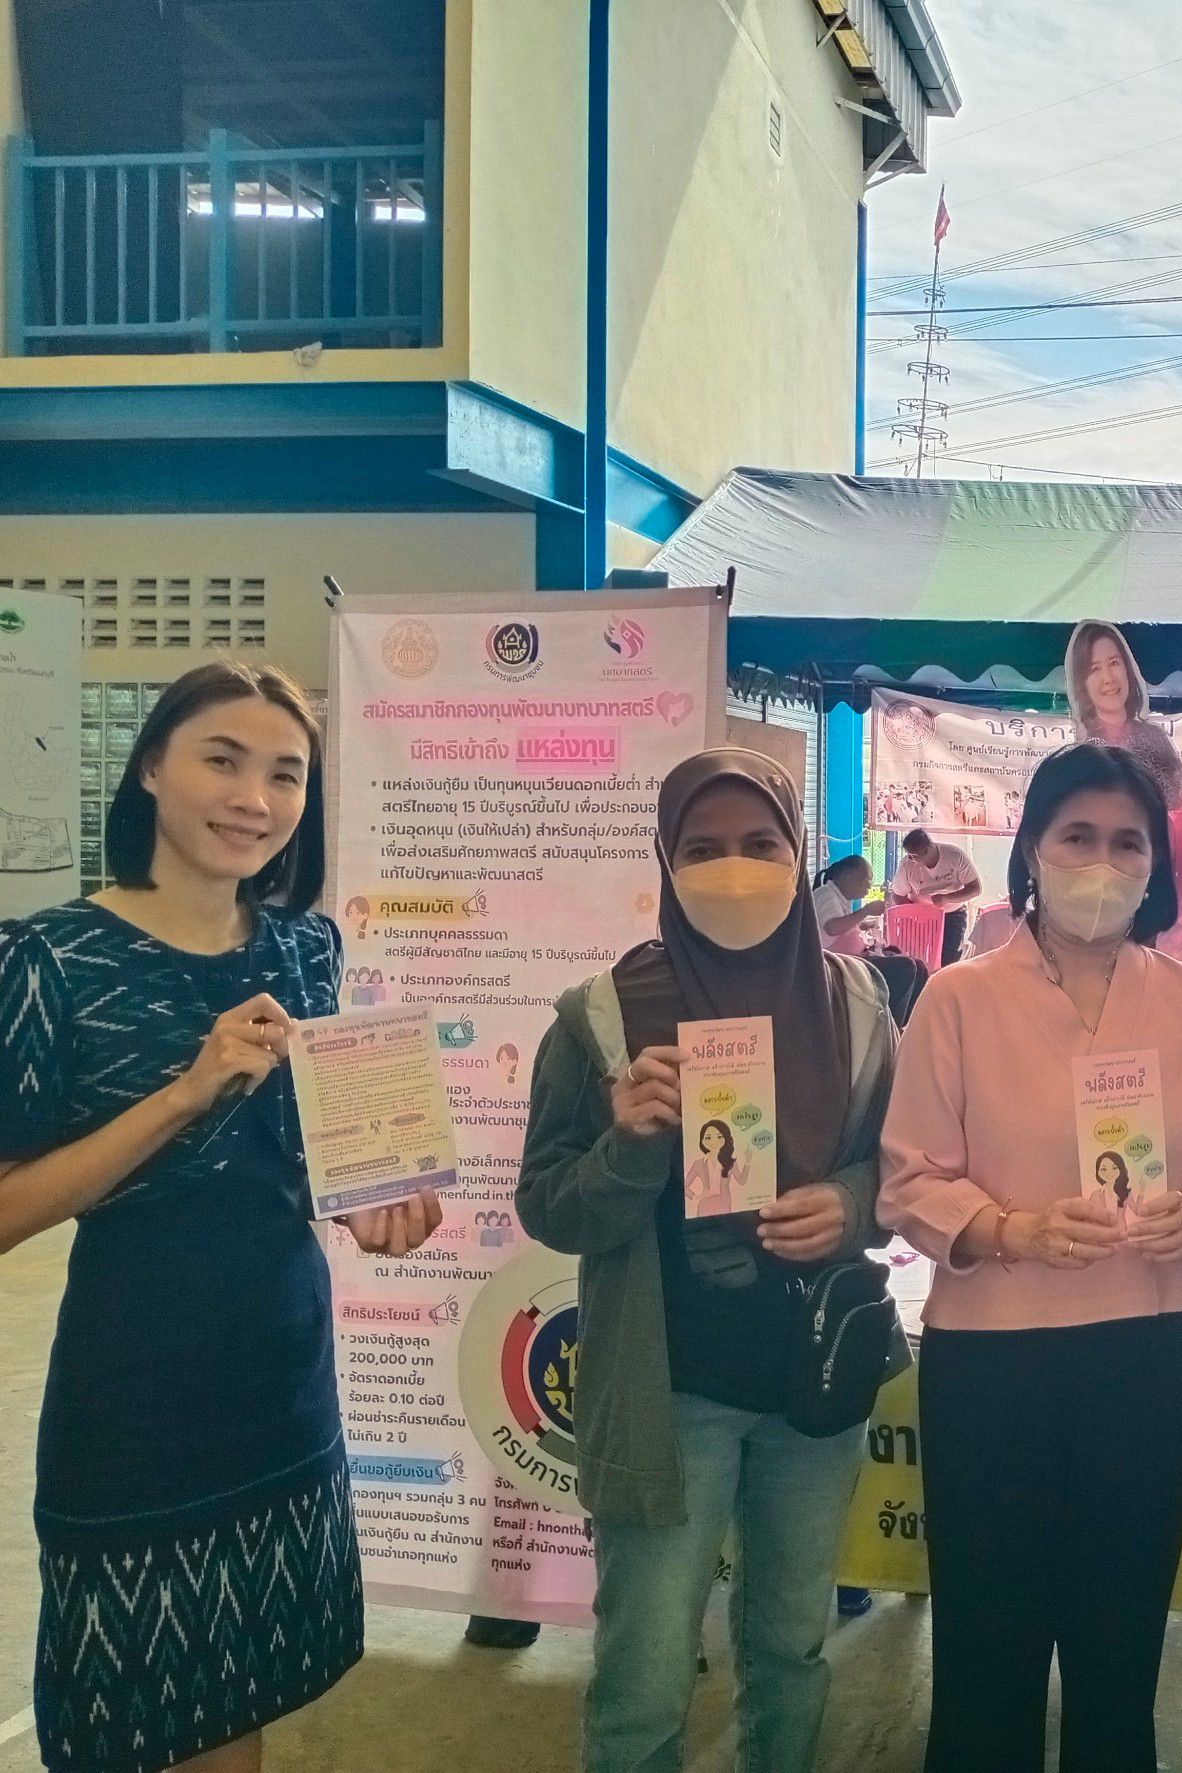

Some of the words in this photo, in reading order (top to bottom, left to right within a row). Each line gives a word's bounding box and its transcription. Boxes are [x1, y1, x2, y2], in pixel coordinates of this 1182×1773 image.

[362, 697, 654, 723] สมัครสมาชิกกองทุนพัฒนาบทบาทสตรี
[410, 736, 510, 760] มีสิทธิเข้าถึง
[516, 730, 616, 765] แหล่งทุน
[382, 777, 469, 794] แหล่งเงินกู้ยืม
[474, 773, 641, 795] เป็นทุนหมุนเวียนดอกเบี้ยต่ำ
[645, 777, 663, 791] สำ
[381, 801, 458, 816] สตรีไทยอายุ
[462, 801, 475, 813] 15
[480, 796, 570, 817] ปีบริบูรณ์ขึ้นไป
[575, 797, 659, 813] เพื่อประกอบอ
[381, 823, 453, 840] เงินอุดหนุน
[381, 840, 537, 860] เพื่อส่งเสริมศักยภาพสตรี
[542, 845, 650, 863] สนับสนุนโครงการ
[380, 865, 543, 881] แก้ไขปัญหาและพัฒนาสตรี
[380, 898, 454, 922] คุณสมบัติ
[384, 927, 508, 944] ประเภทบุคคลธรรมดา
[385, 946, 482, 961] สตรีผู้มีสัญชาติไทย
[485, 948, 528, 963] และมีอายุ
[531, 949, 542, 960] 15
[400, 972, 511, 988] ประเภทองค์กรสตรี
[342, 1306, 421, 1322] สิทธิประโยชน์
[350, 1333, 430, 1349] วงเงินกู้สูงสุด
[350, 1352, 407, 1367] 200,000
[411, 1356, 434, 1367] บาท
[349, 1370, 425, 1386] อัตราดอกเบี้ย
[348, 1390, 385, 1404] ร้อยละ
[389, 1393, 414, 1405] 0.10
[419, 1392, 445, 1406] ต่อปี
[348, 1410, 466, 1428] ผ่อนชำระคืนรายเดือน
[348, 1428, 382, 1443] ไม่เกิน
[387, 1432, 394, 1443] 2
[398, 1430, 407, 1444] ปี
[406, 1492, 453, 1507] รวมกลุ่ม
[458, 1494, 465, 1505] 3
[469, 1497, 487, 1507] คน
[494, 1517, 526, 1531] Email
[431, 1529, 483, 1547] สำนักงาน
[492, 1535, 523, 1551] หรือที่
[491, 1558, 532, 1573] ทุกแห่ง
